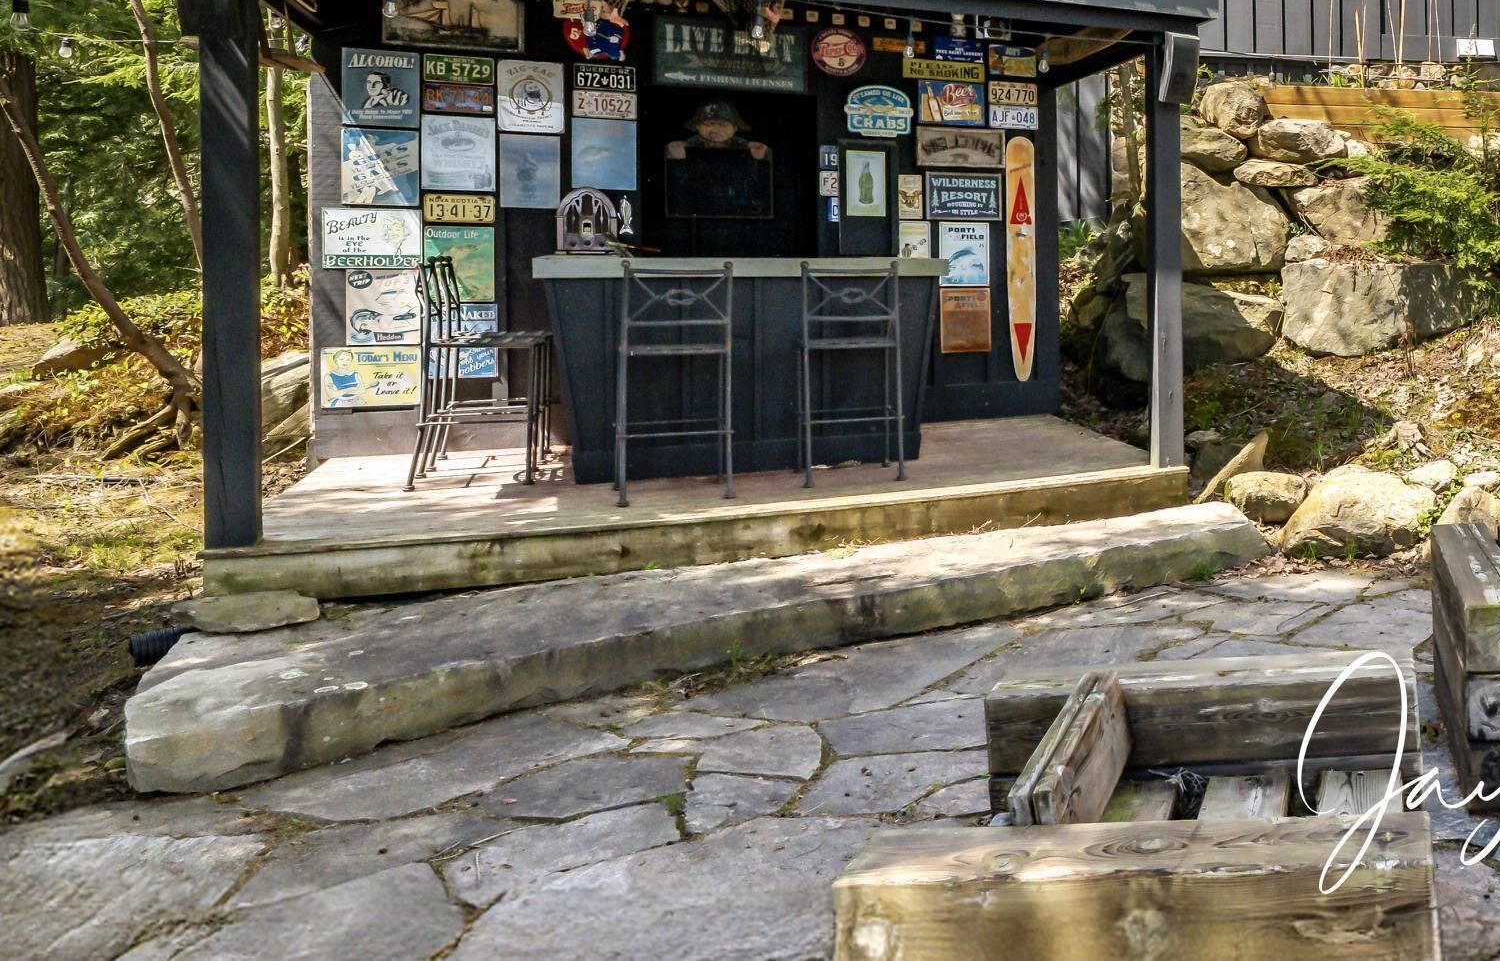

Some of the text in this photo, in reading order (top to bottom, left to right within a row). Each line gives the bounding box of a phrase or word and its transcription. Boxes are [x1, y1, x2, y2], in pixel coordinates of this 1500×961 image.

[664, 23, 725, 53] LIVE
[347, 53, 415, 69] ALCOHOL!
[910, 61, 953, 70] PLEASE
[426, 60, 491, 79] KB 5729
[910, 66, 980, 80] NO SMOKING
[745, 77, 794, 89] LICENSES
[941, 84, 975, 105] Beer
[594, 98, 632, 114] 10522
[852, 116, 906, 130] CRABS
[992, 109, 1011, 123] AJF
[1016, 111, 1036, 125] 048
[930, 177, 997, 189] WILDERNESS
[940, 191, 988, 204] RESORT
[326, 211, 378, 235] BEAUTY
[426, 228, 480, 239] Outdoor Life
[325, 255, 419, 267] BEERHOLDER
[349, 272, 368, 281] NEXT
[351, 278, 371, 287] TRIP
[460, 306, 496, 321] NAKED
[354, 351, 418, 363] TODAY'S MENU
[373, 371, 405, 380] Take it
[375, 388, 401, 396] Leave
